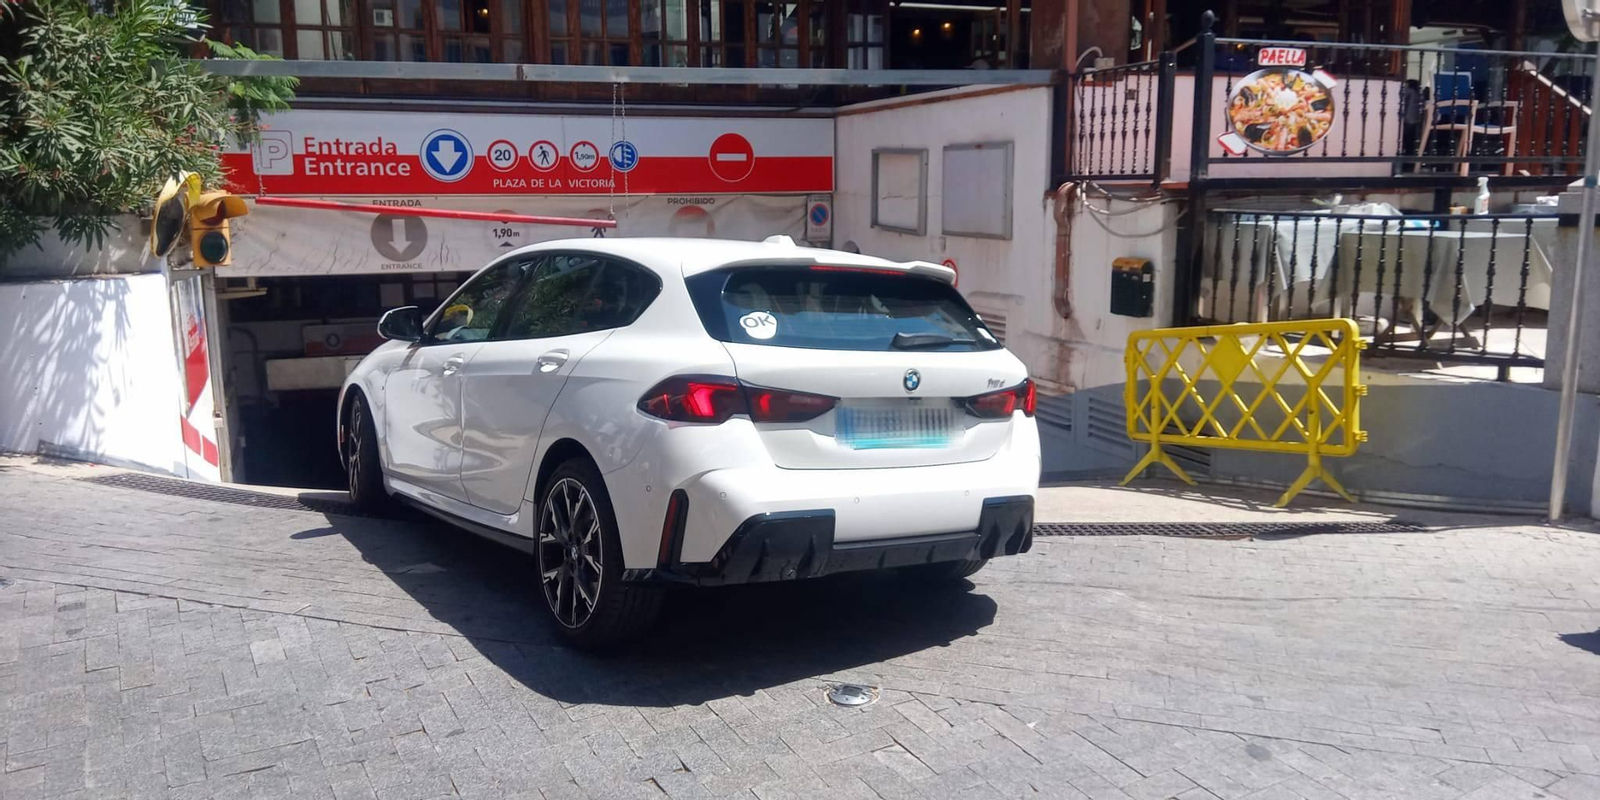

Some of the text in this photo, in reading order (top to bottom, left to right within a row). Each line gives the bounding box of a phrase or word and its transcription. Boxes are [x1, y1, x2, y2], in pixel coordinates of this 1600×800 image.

[1260, 49, 1305, 64] PAELLA
[304, 136, 398, 155] Entrada
[260, 138, 288, 170] P
[494, 149, 511, 161] 20
[304, 157, 411, 176] Entrance
[493, 179, 615, 188] PLAZA DE LA VICTORIA
[372, 199, 422, 207] ENTRADA
[667, 197, 716, 205] PROHIBIDO
[381, 262, 423, 270] ENTRANCE
[743, 315, 775, 328] OK
